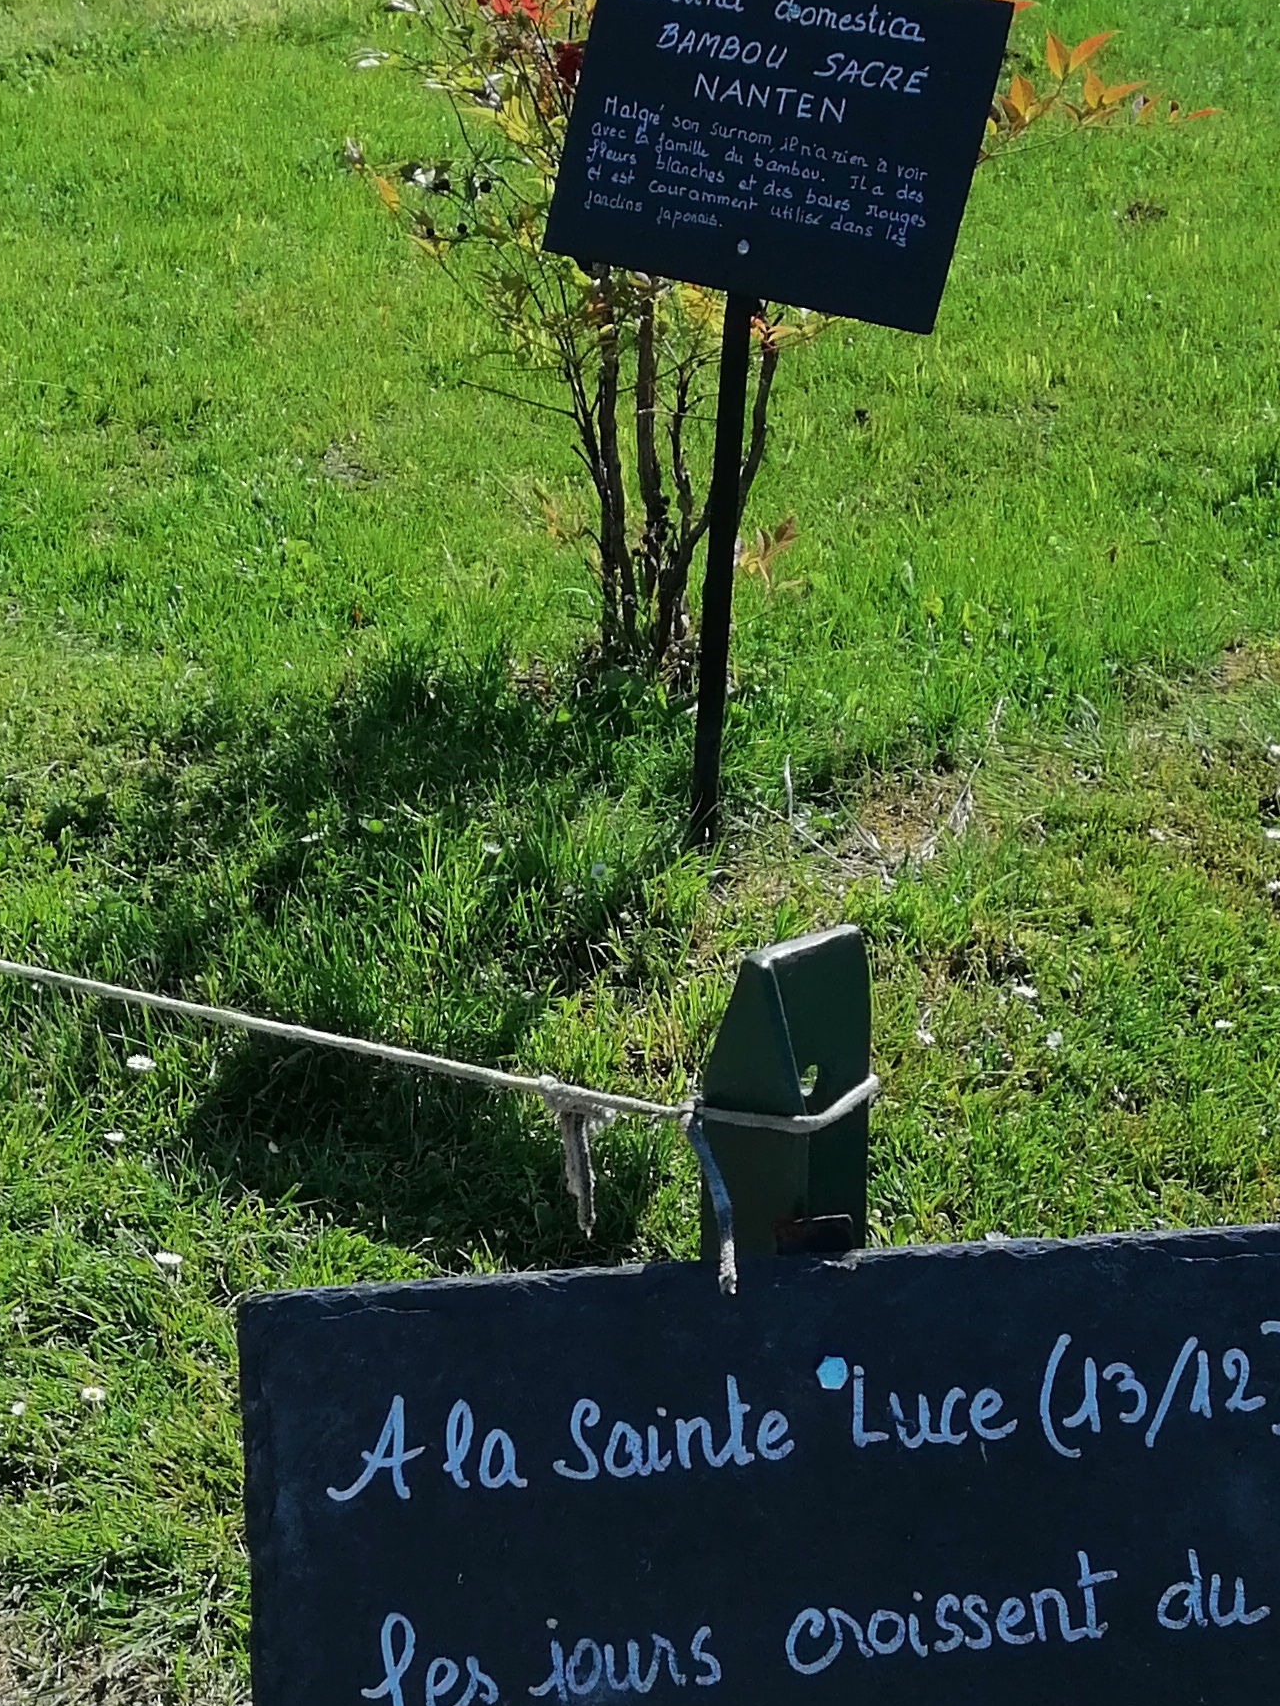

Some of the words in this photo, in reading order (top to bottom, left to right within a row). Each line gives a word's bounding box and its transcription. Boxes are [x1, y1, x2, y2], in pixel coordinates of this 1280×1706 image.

[656, 22, 788, 70] BAMBOU
[813, 52, 930, 93] SACRÉ
[694, 72, 846, 123] NANTEN
[591, 122, 627, 140] avec
[655, 132, 709, 158] famille
[724, 146, 744, 165] du
[871, 186, 884, 196] a
[895, 183, 924, 204] des
[604, 95, 665, 132] Malgré
[672, 116, 700, 133] son
[831, 150, 869, 168] rien
[897, 164, 928, 181] voir
[584, 189, 643, 213] jardins
[586, 138, 638, 165] fleurs
[655, 154, 725, 183] blanches
[738, 174, 758, 190] et
[763, 180, 793, 199] des
[805, 188, 851, 212] baies
[865, 204, 926, 236] rouges
[587, 163, 601, 181] et
[611, 168, 635, 185] est
[648, 179, 759, 211] couramment
[830, 214, 874, 237] dans
[885, 224, 907, 248] les
[326, 1394, 426, 1502] A
[442, 1396, 529, 1491] la
[552, 1373, 795, 1482] Sainte
[845, 1365, 1019, 1452] Luce
[785, 1549, 1119, 1676] croissent
[1156, 1548, 1271, 1628] du
